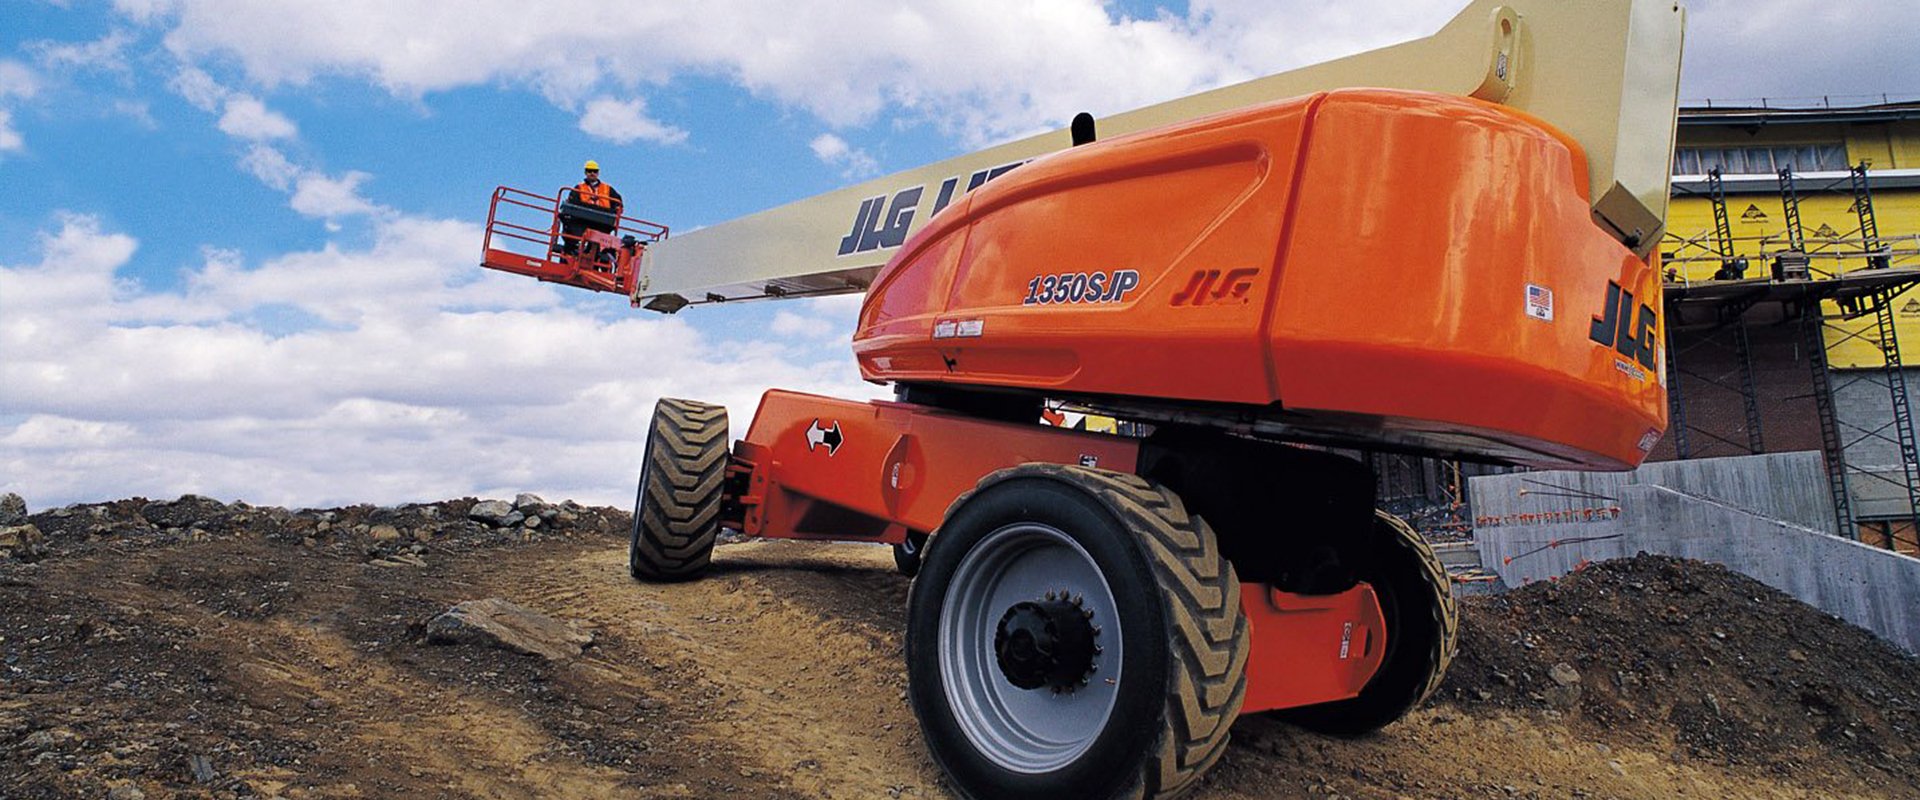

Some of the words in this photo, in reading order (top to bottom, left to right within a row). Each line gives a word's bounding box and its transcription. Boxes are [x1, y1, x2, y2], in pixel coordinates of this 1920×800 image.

[837, 185, 924, 256] JLG
[1024, 270, 1139, 305] 1350SJP
[1170, 267, 1259, 306] JLG
[1589, 278, 1656, 372] JLG
